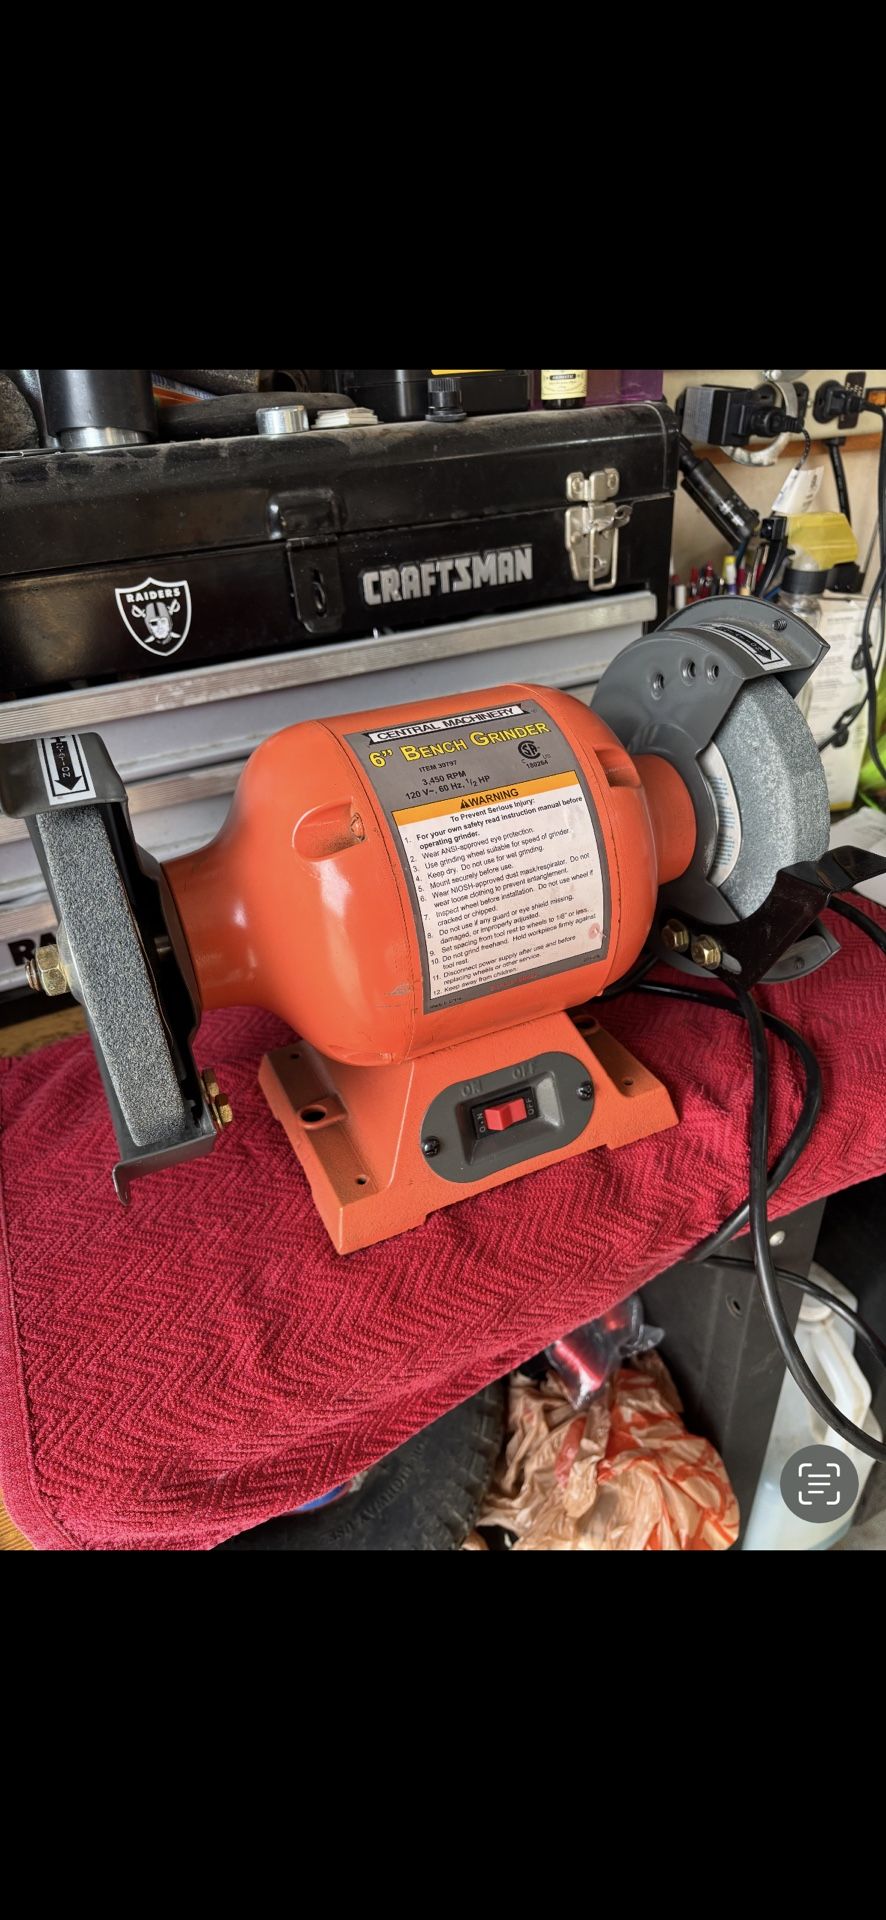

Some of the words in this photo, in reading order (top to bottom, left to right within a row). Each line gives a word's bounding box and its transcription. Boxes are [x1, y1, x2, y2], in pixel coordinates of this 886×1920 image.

[362, 546, 533, 606] CRAFTSMAN
[126, 586, 182, 604] RAIDERS
[377, 723, 438, 740] CENTRAL
[443, 708, 514, 728] MACHINERY
[400, 740, 468, 761] BENCH
[469, 723, 551, 747] GRINDER
[419, 764, 437, 773] ITEM
[422, 777, 445, 786] 3,450
[446, 770, 467, 781] RPM
[406, 790, 421, 800] 120
[439, 782, 449, 792] 60
[451, 781, 465, 791] Hz,
[479, 775, 490, 784] HP
[469, 788, 519, 806] WARNING
[430, 830, 446, 839] your
[464, 820, 484, 830] safety
[485, 816, 500, 825] read
[501, 808, 537, 820] instruction
[538, 802, 561, 811] manual
[562, 797, 582, 805] before
[460, 810, 487, 820] Prevent
[487, 803, 513, 813] Serious
[514, 798, 535, 807] Injury:
[420, 838, 453, 849] operating
[454, 832, 480, 842] grinder.
[422, 851, 440, 859] Wear
[441, 838, 489, 855] ANSI-approved
[490, 835, 502, 843] eye
[440, 854, 465, 867] grinding
[466, 850, 486, 859] wheel
[487, 843, 510, 856] suitable
[522, 835, 540, 845] speed
[428, 870, 445, 879] Keep
[496, 853, 504, 861] for
[430, 879, 450, 889] Mount
[452, 872, 478, 883] securely
[479, 867, 499, 876] before
[432, 890, 449, 899] Wear
[451, 875, 504, 894] NIOSH-approved
[506, 871, 518, 880] dust
[434, 899, 450, 908] wear
[452, 894, 468, 902] loose
[470, 888, 494, 898] clothing
[503, 879, 525, 890] prevent
[527, 868, 568, 883] entanglement.
[436, 907, 459, 918] Inspect
[460, 901, 479, 911] wheel
[480, 896, 500, 906] before
[571, 872, 588, 881] wheel
[492, 909, 510, 922] guard
[532, 901, 548, 910] shield
[550, 894, 574, 904] missing.
[438, 916, 462, 926] cracked
[480, 920, 512, 933] improperly
[454, 939, 477, 949] spacing
[494, 930, 505, 938] tool
[527, 919, 547, 929] wheels
[464, 947, 479, 957] grind
[481, 939, 509, 950] freehand.
[528, 926, 557, 938] workpiece
[575, 914, 596, 924] against
[443, 963, 478, 978] Disconnect
[479, 958, 496, 968] power
[499, 952, 517, 962] supply
[519, 948, 532, 956] after
[558, 935, 576, 944] before
[444, 973, 472, 985] replacing
[473, 967, 494, 976] wheels
[462, 979, 478, 987] away
[511, 1062, 538, 1079] OFF
